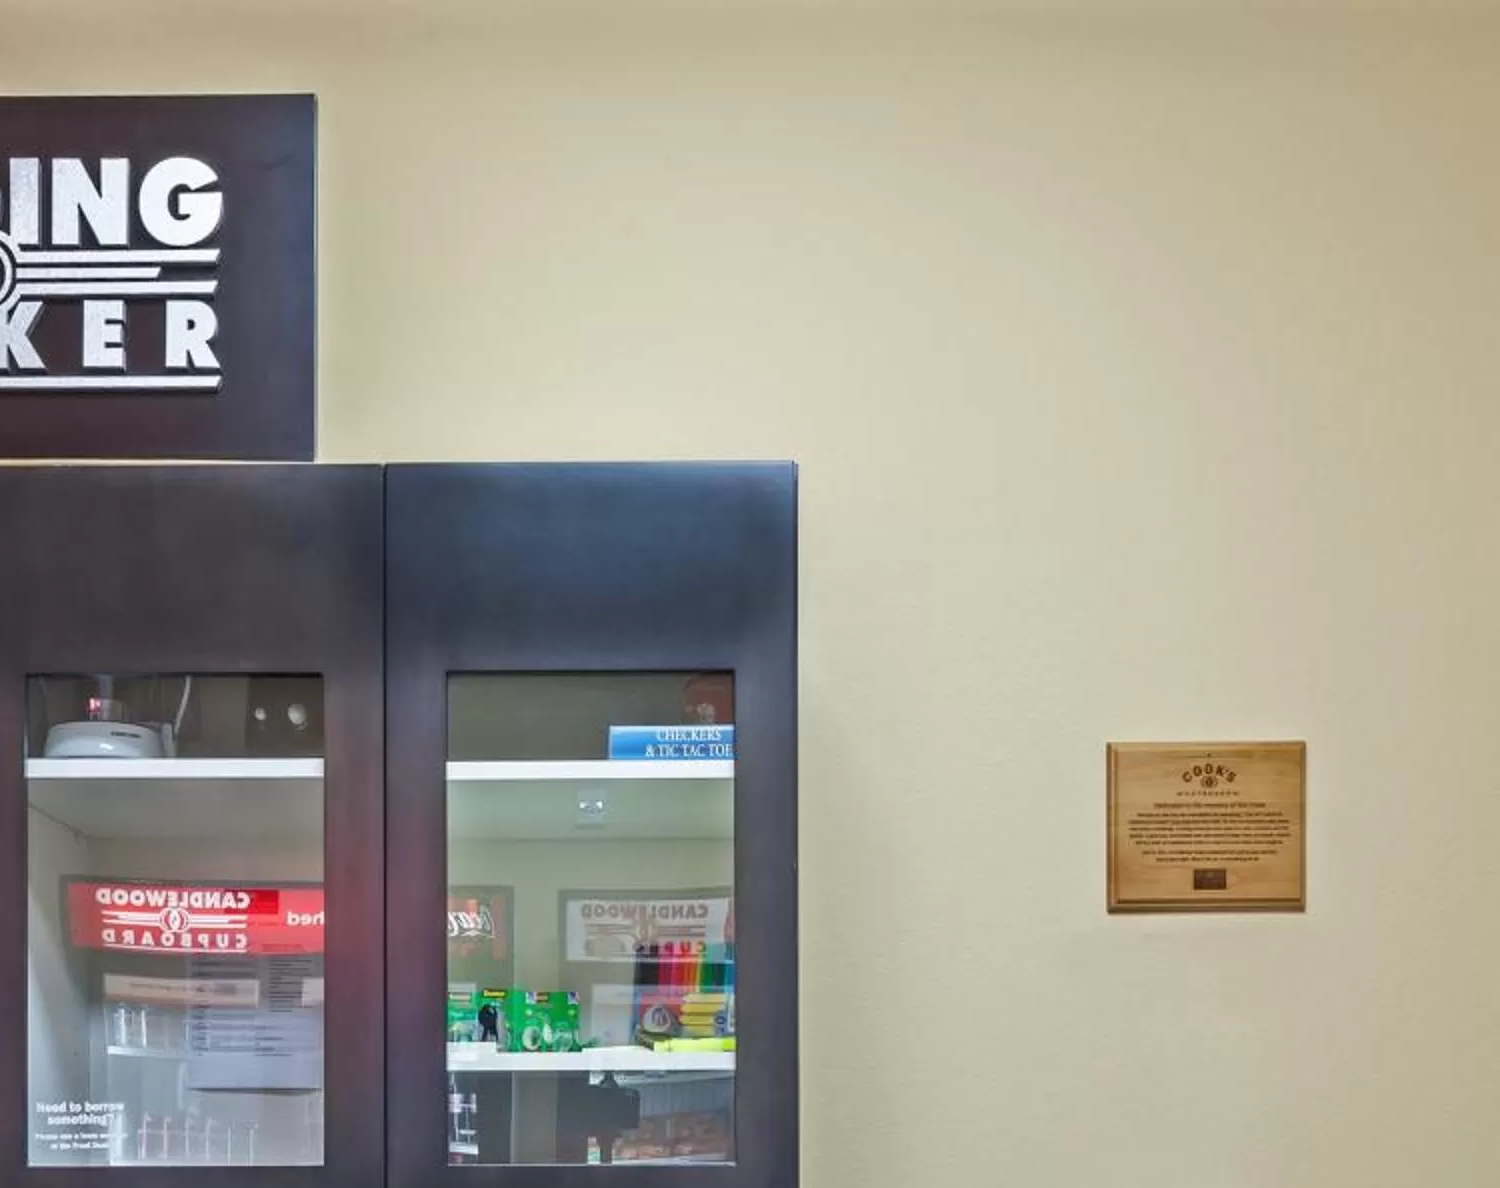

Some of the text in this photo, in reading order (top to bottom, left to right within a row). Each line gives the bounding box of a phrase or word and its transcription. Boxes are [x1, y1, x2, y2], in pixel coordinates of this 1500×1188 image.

[656, 728, 721, 741] CHECKERS
[645, 744, 655, 757] &
[658, 744, 679, 757] TIC
[682, 744, 705, 757] TAC
[1182, 763, 1237, 783] COOK'S
